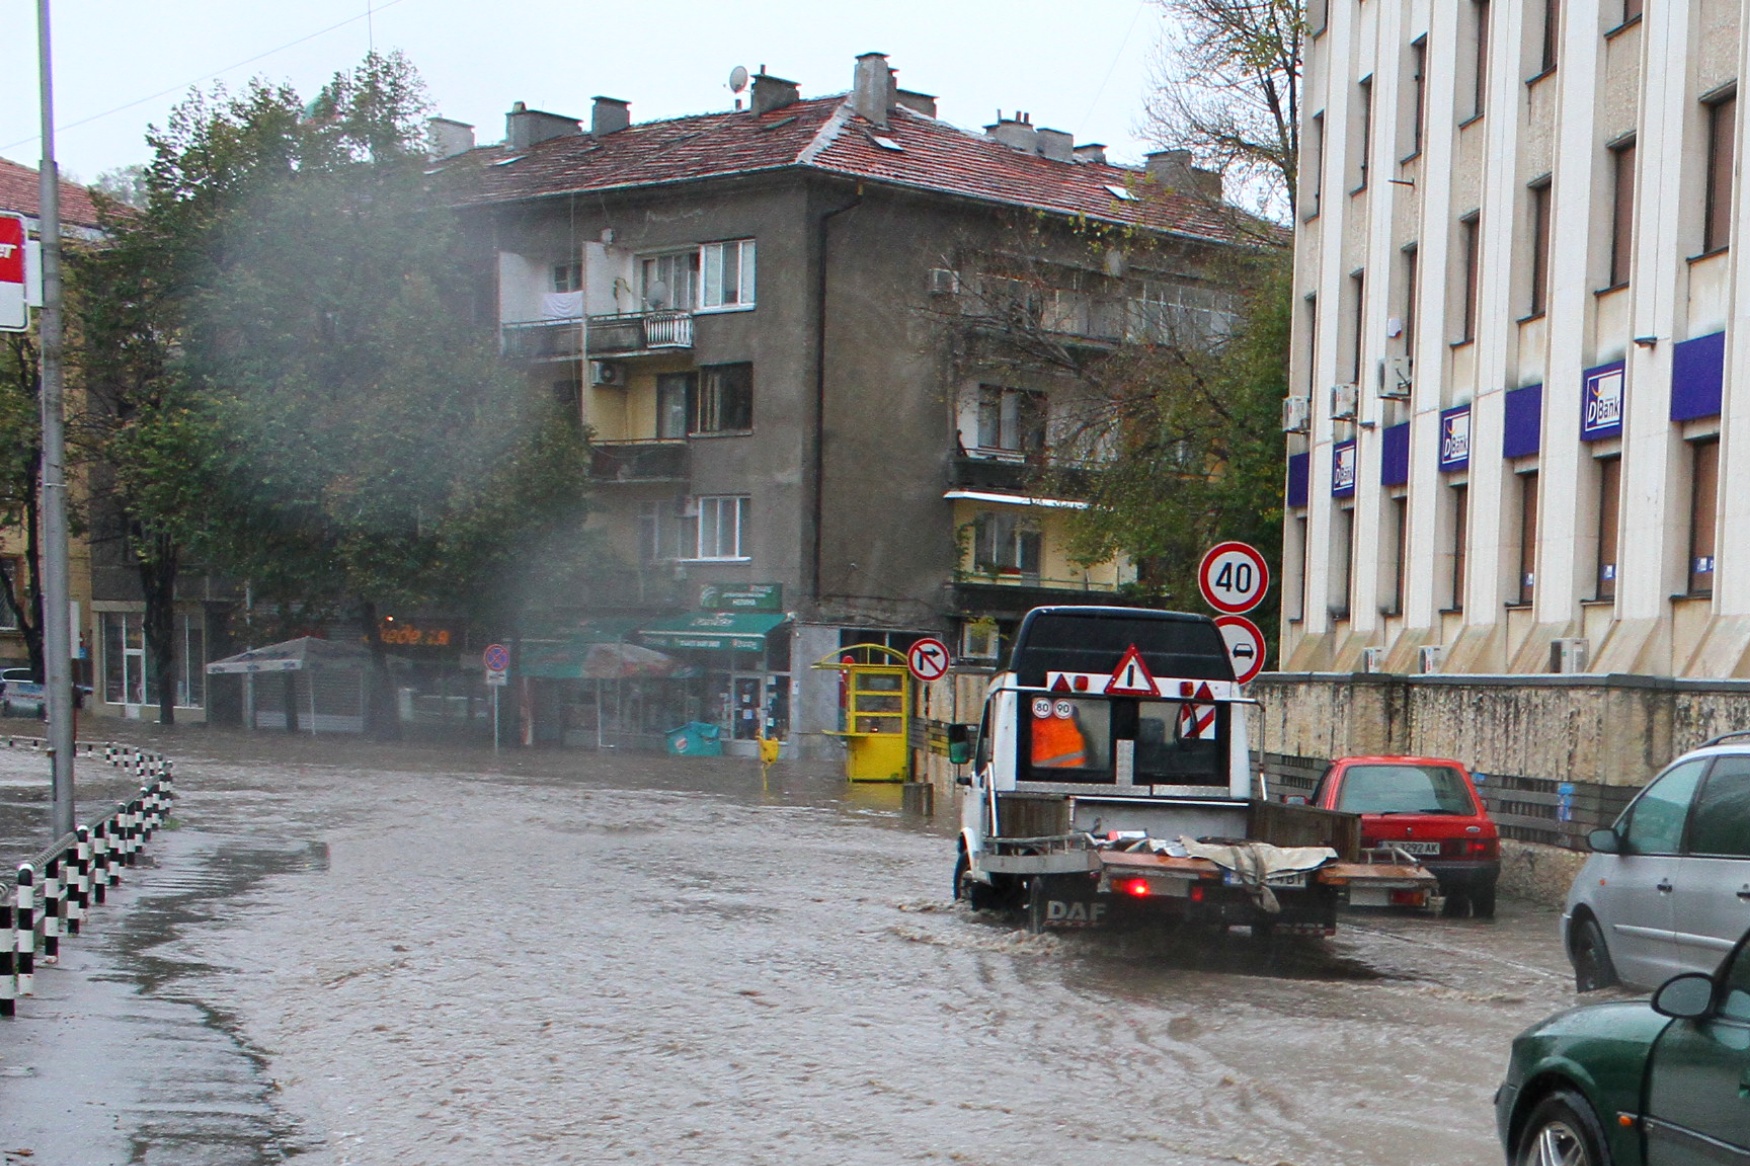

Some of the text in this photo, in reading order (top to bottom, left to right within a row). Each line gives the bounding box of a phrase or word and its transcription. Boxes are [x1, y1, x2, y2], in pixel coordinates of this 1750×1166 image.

[1215, 562, 1252, 593] 40
[1056, 704, 1070, 713] 90
[1046, 900, 1107, 921] DAF
